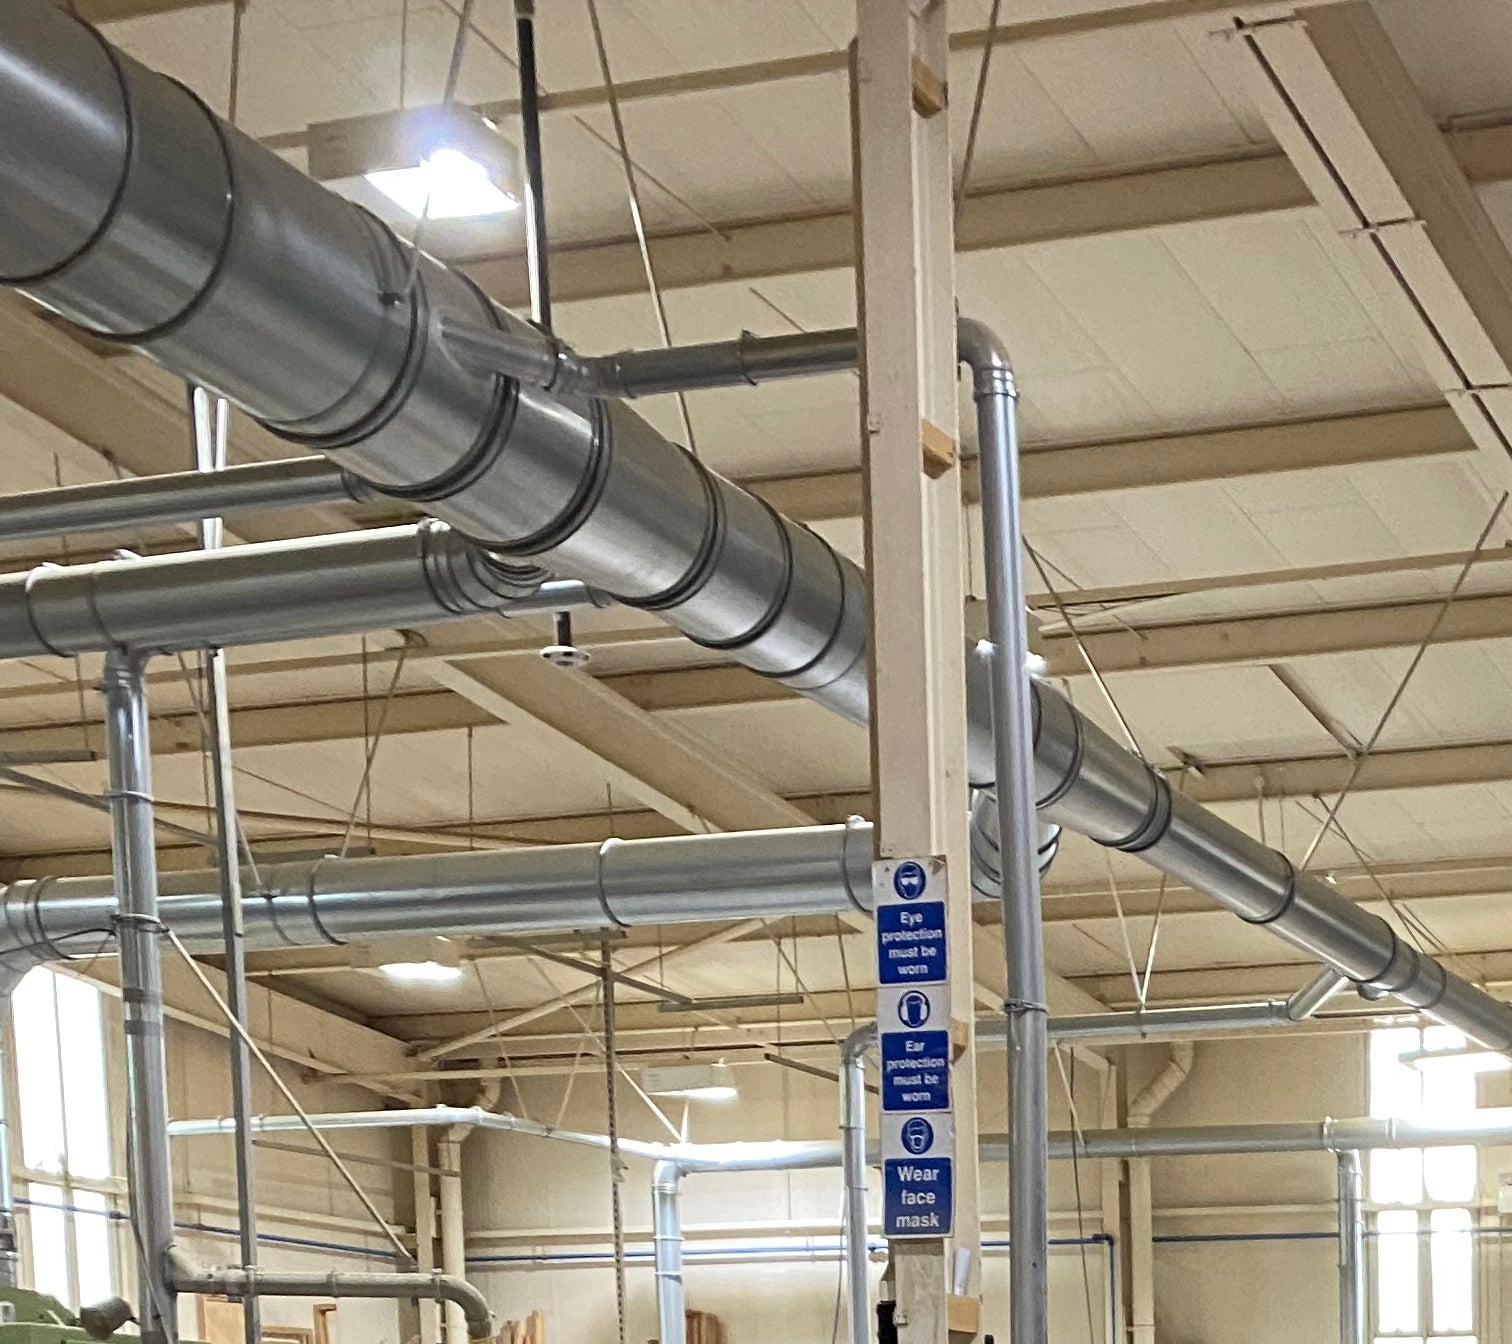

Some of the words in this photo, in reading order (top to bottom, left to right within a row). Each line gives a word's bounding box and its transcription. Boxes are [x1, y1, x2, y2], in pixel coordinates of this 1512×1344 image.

[900, 911, 923, 928] Eye
[881, 928, 943, 945] protection
[888, 947, 918, 959] must
[920, 945, 937, 957] be
[897, 964, 929, 975] worn
[905, 1040, 925, 1053] Ear
[886, 1057, 945, 1073] protection
[893, 1074, 922, 1086] must
[924, 1072, 939, 1085] be
[901, 1092, 931, 1102] worn
[897, 1165, 940, 1182] Wear
[901, 1189, 936, 1205] face
[895, 1211, 940, 1228] mask
